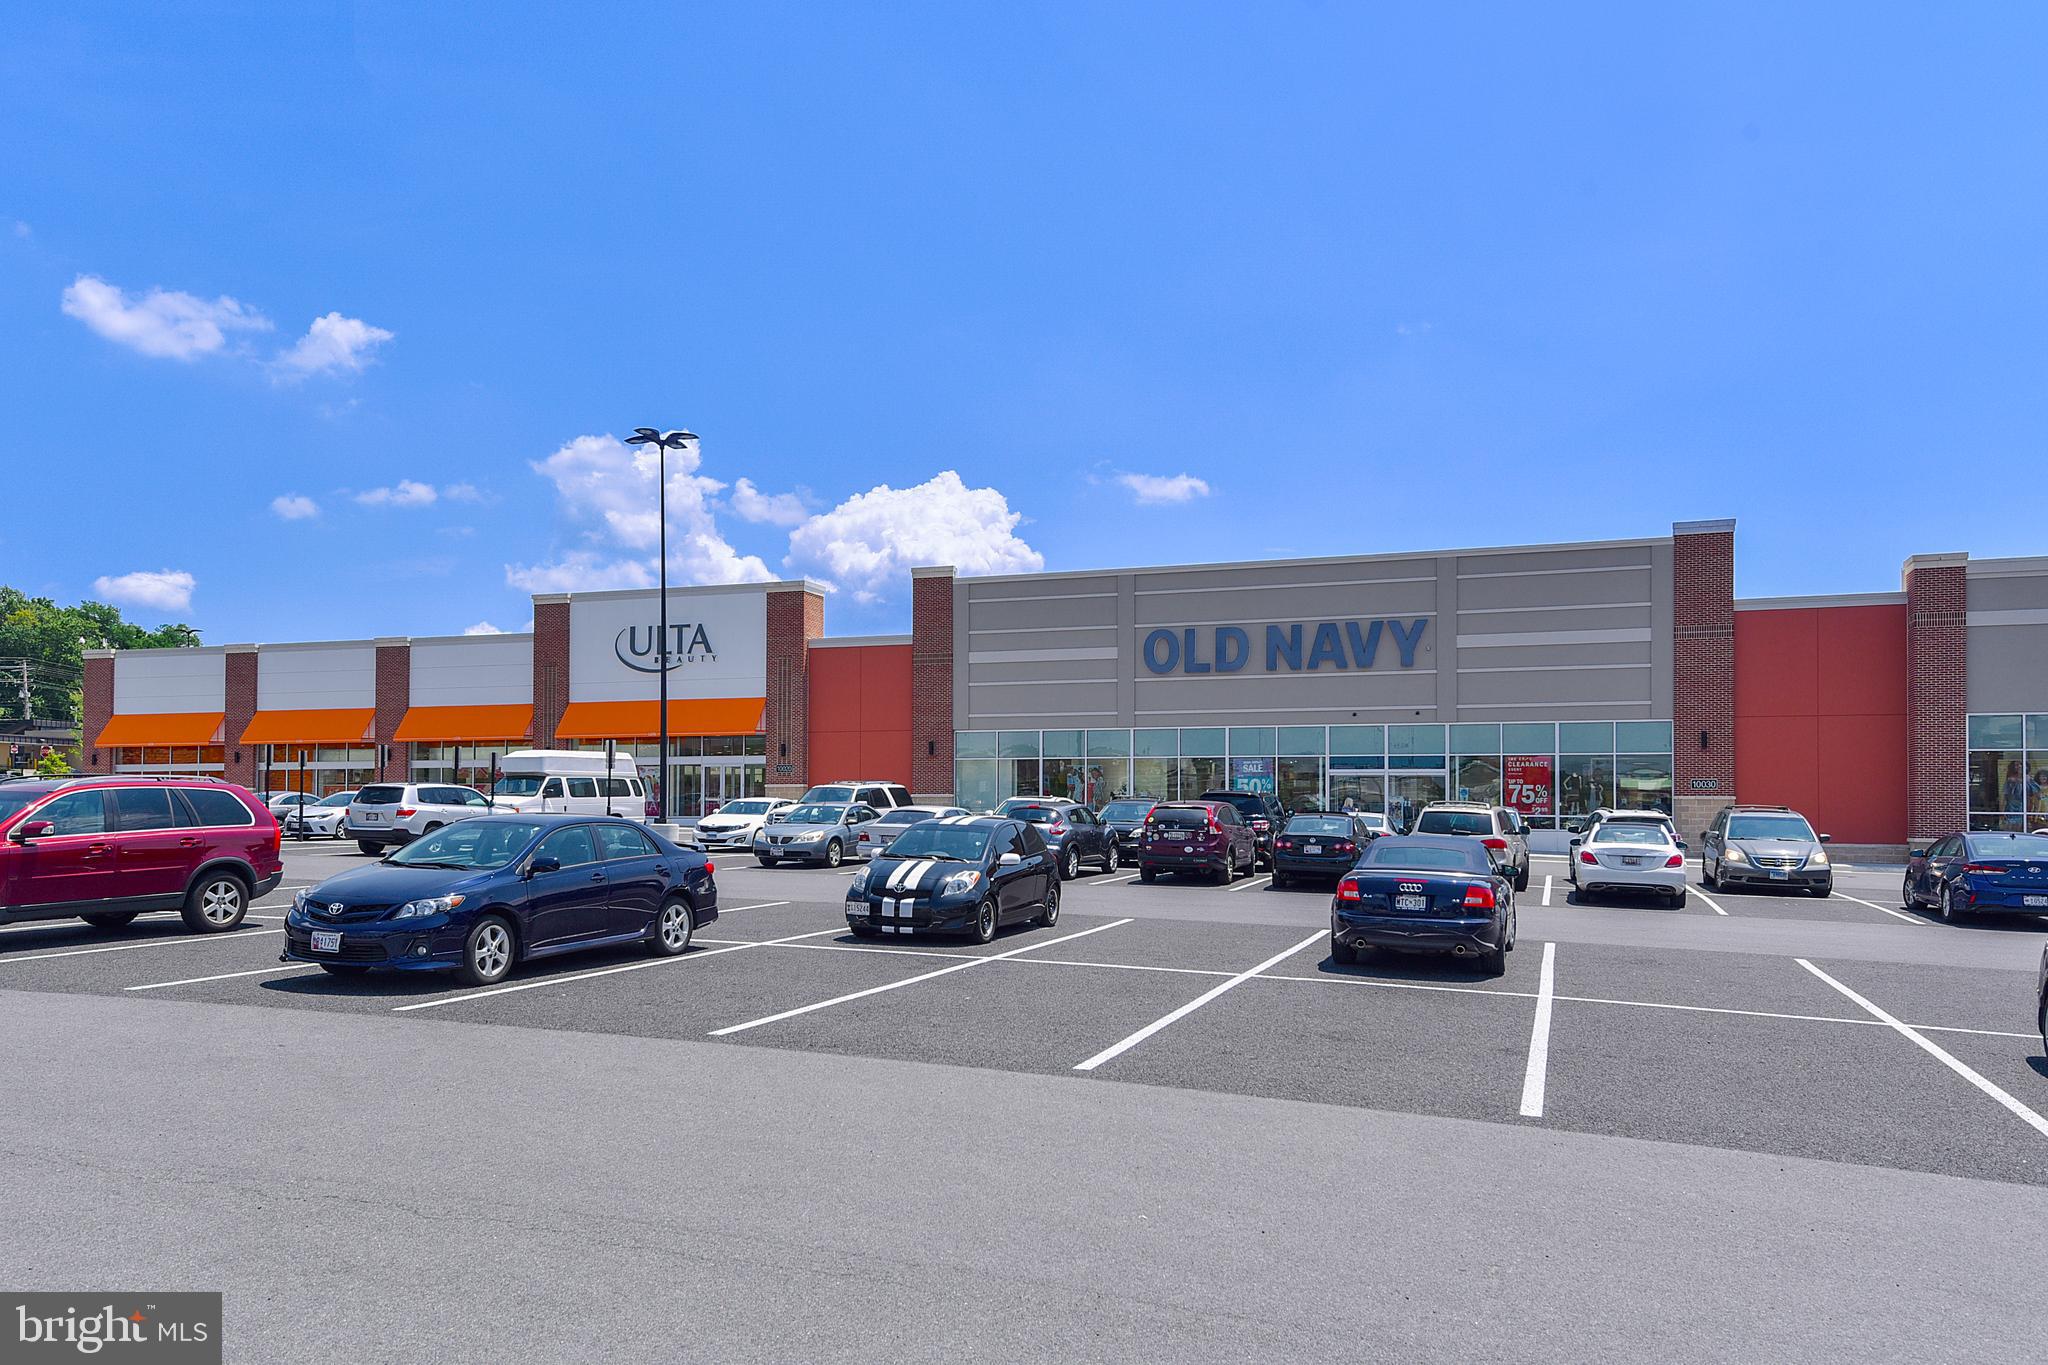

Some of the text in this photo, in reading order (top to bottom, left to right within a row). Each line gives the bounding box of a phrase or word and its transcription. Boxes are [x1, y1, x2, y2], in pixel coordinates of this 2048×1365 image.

[629, 623, 713, 657] ULTA
[1143, 618, 1429, 674] OLD NAVY
[1242, 764, 1264, 773] SALE
[1508, 784, 1548, 804] 75%
[1692, 780, 1716, 788] 10030
